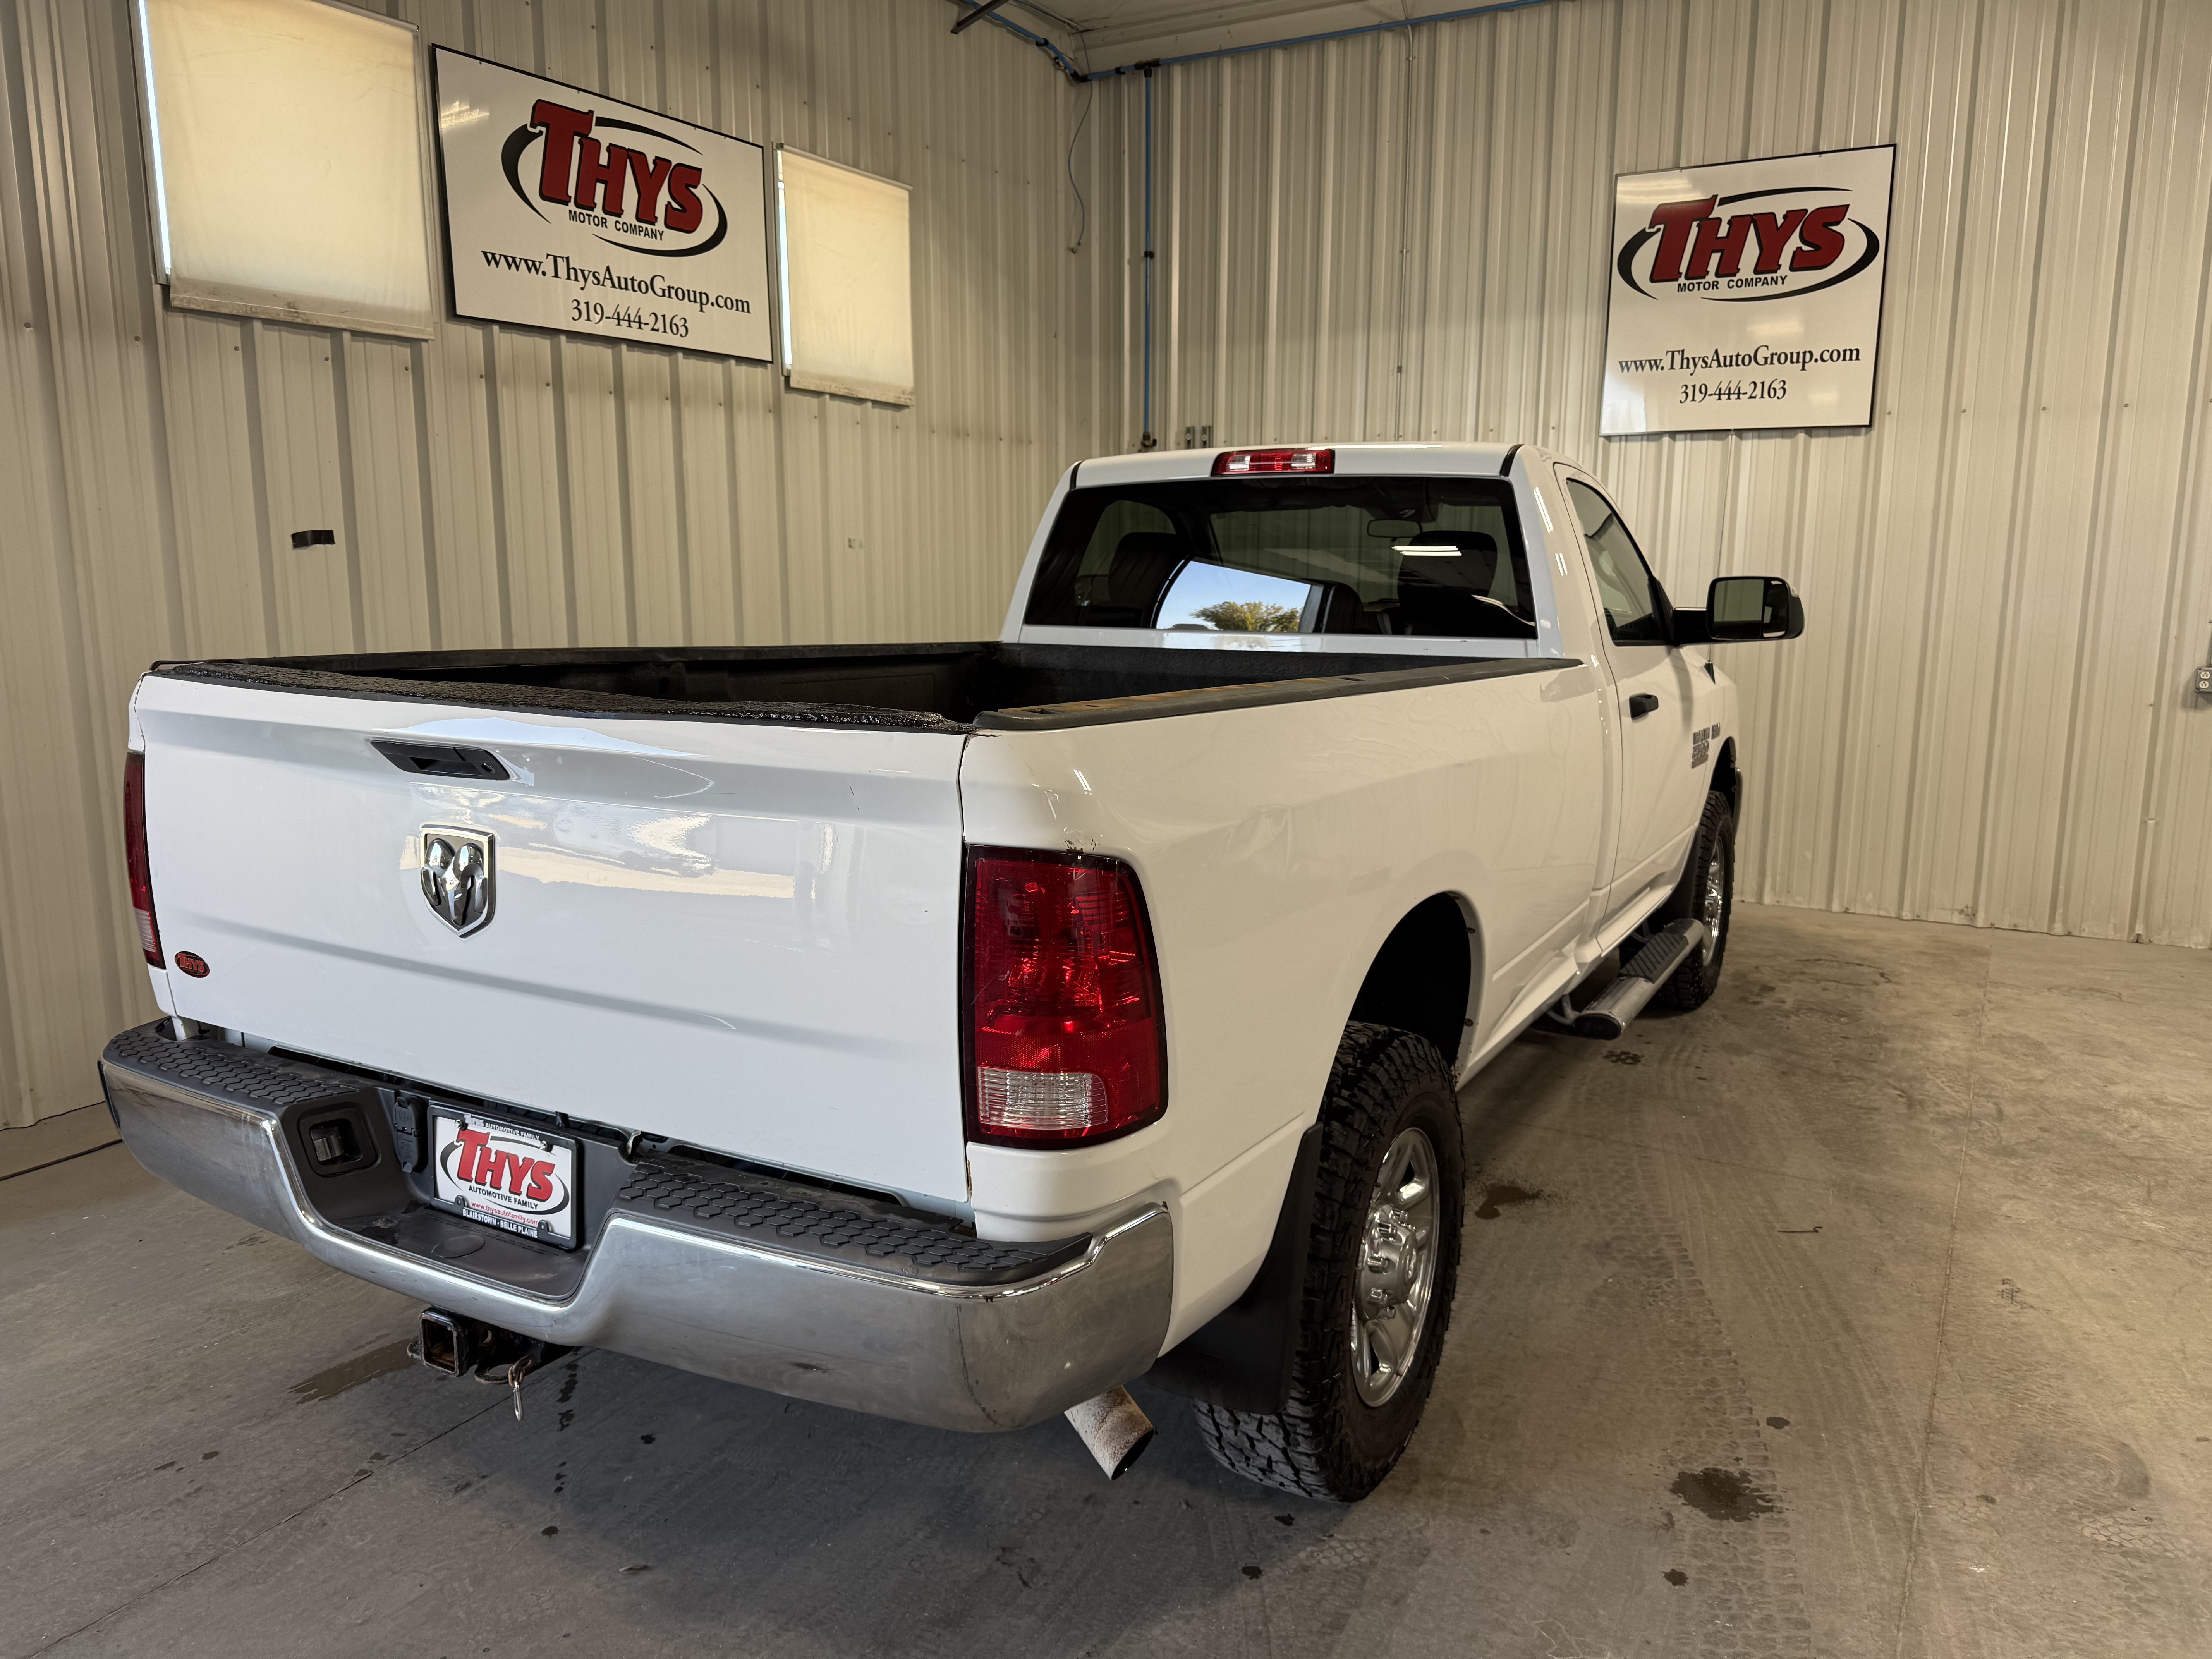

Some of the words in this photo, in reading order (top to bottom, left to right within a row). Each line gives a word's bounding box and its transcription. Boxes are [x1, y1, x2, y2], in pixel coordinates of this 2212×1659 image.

[529, 98, 703, 234] THYS
[569, 209, 608, 229] MOTOR
[615, 220, 665, 242] COMPANY
[1648, 194, 1850, 283] THYS
[481, 251, 751, 314] www.ThysAutoGroup.com
[1677, 280, 1719, 293] MOTOR
[1727, 275, 1788, 289] COMPANY
[571, 299, 689, 338] 319-444-2163
[1618, 345, 1860, 376] www.ThysAutoGroup.com
[1679, 379, 1787, 404] 319-444-2163
[177, 953, 205, 972] THYS
[485, 1122, 520, 1136] AUTOMOTIVE
[520, 1131, 539, 1141] FAMILY
[455, 1129, 556, 1202] THYS
[469, 1185, 512, 1203] AUTOMOTIVE
[514, 1198, 538, 1210] FAMILY
[463, 1209, 496, 1226] BLAIRSTOWN
[500, 1220, 517, 1232] BELLE
[518, 1226, 538, 1238] PLAINE
[471, 1202, 539, 1225] www.thysautofamily.com
